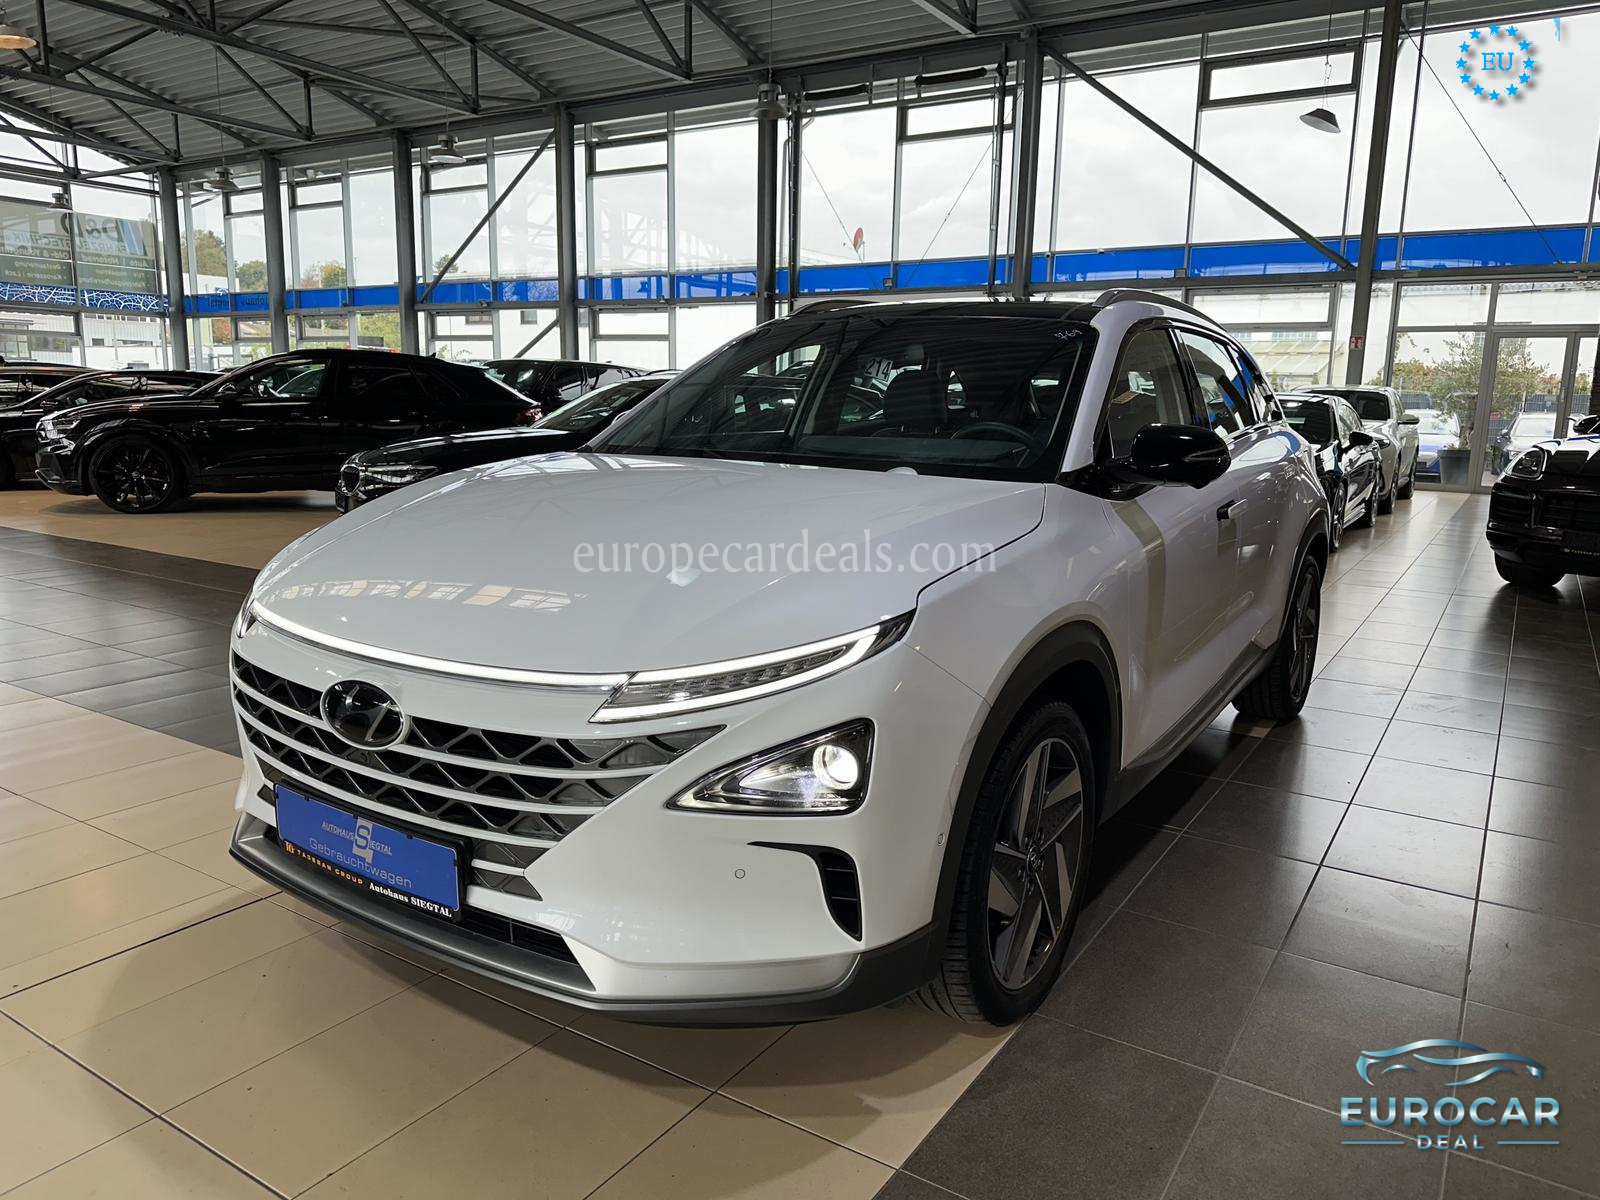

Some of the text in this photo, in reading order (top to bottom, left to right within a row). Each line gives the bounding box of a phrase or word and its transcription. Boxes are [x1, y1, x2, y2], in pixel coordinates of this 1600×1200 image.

[864, 358, 892, 380] 214
[321, 820, 355, 840] AUTOHAUS
[309, 837, 412, 889] Gebrauchtwagen
[335, 867, 364, 885] GROUP
[369, 882, 409, 903] Autohaus
[410, 897, 452, 918] SIEGTAL
